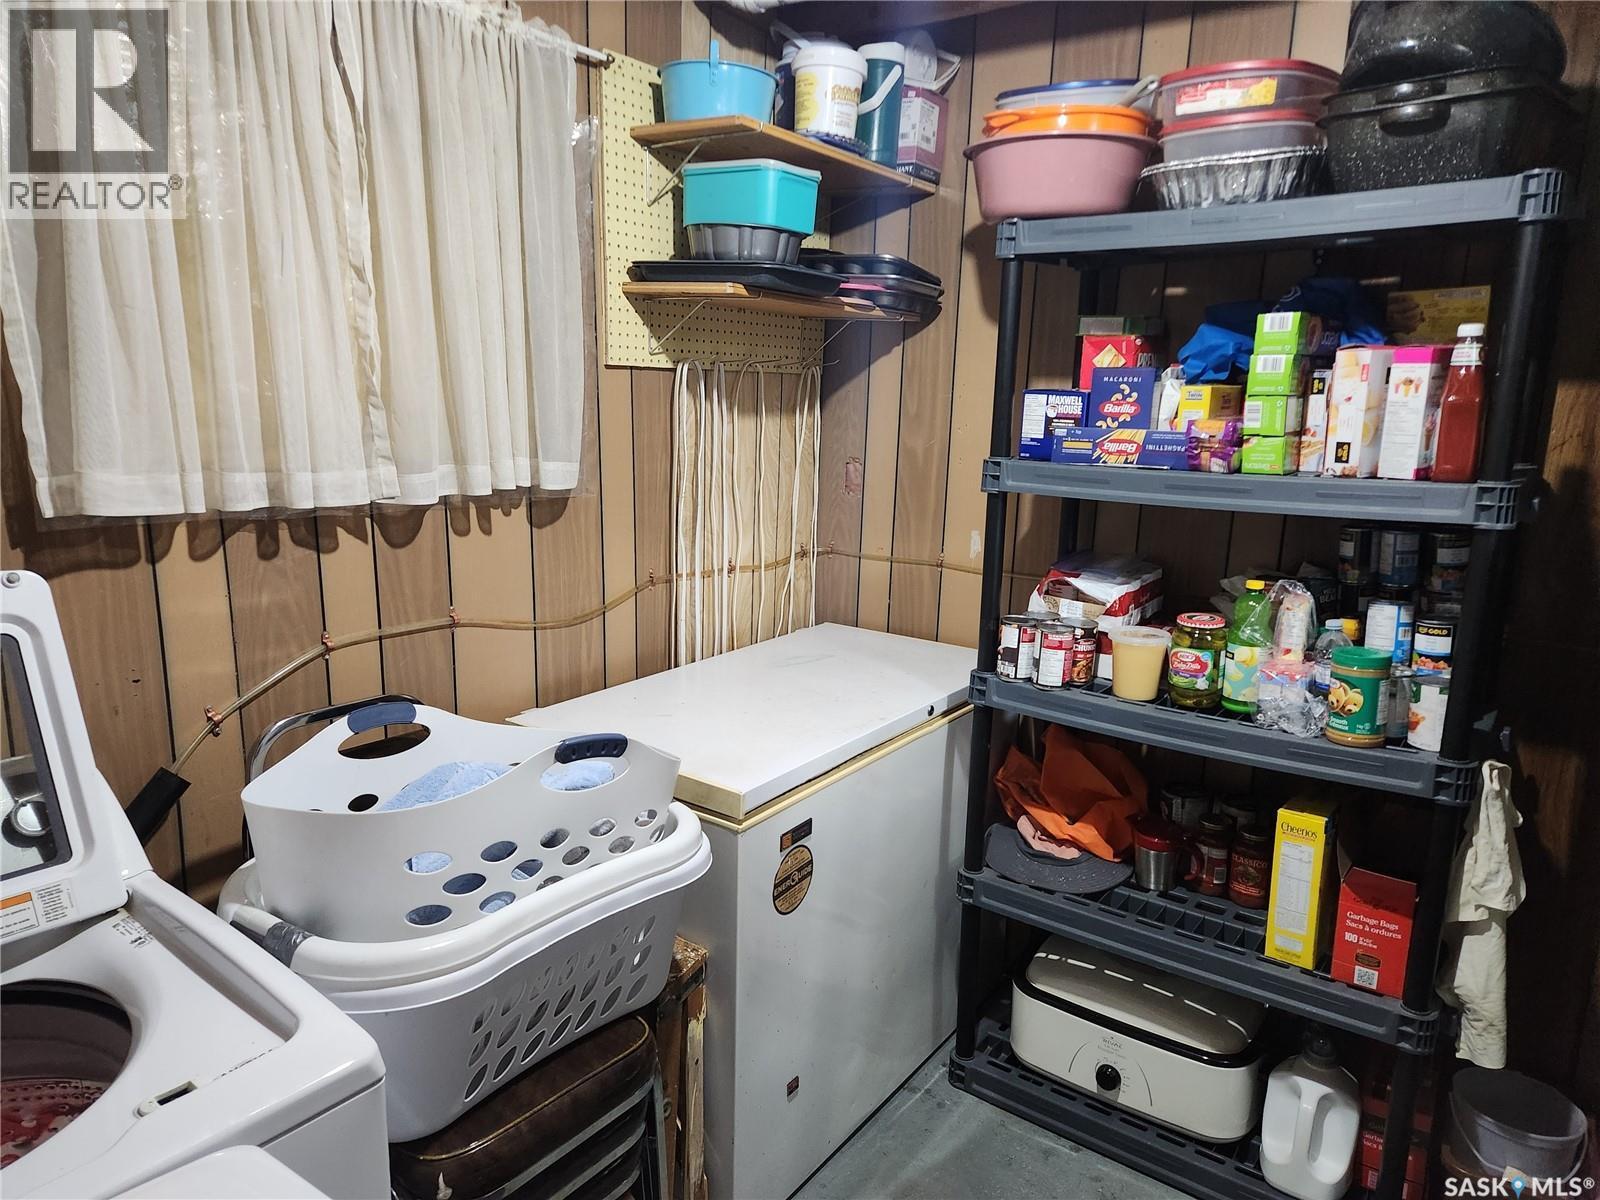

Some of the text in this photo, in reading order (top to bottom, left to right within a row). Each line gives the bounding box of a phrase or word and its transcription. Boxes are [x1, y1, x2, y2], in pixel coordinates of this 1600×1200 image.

[1048, 394, 1083, 405] MAXWELL
[1057, 404, 1083, 415] HOUSE
[1103, 403, 1138, 414] Barilla
[1103, 442, 1138, 453] Barilla
[1145, 443, 1187, 452] PAGHETTINI
[1280, 821, 1318, 840] Cheerios
[1346, 911, 1399, 931] Garbage Bags
[1345, 919, 1363, 930] Sacs
[1370, 926, 1402, 940] ordures
[1344, 931, 1358, 943] 100
